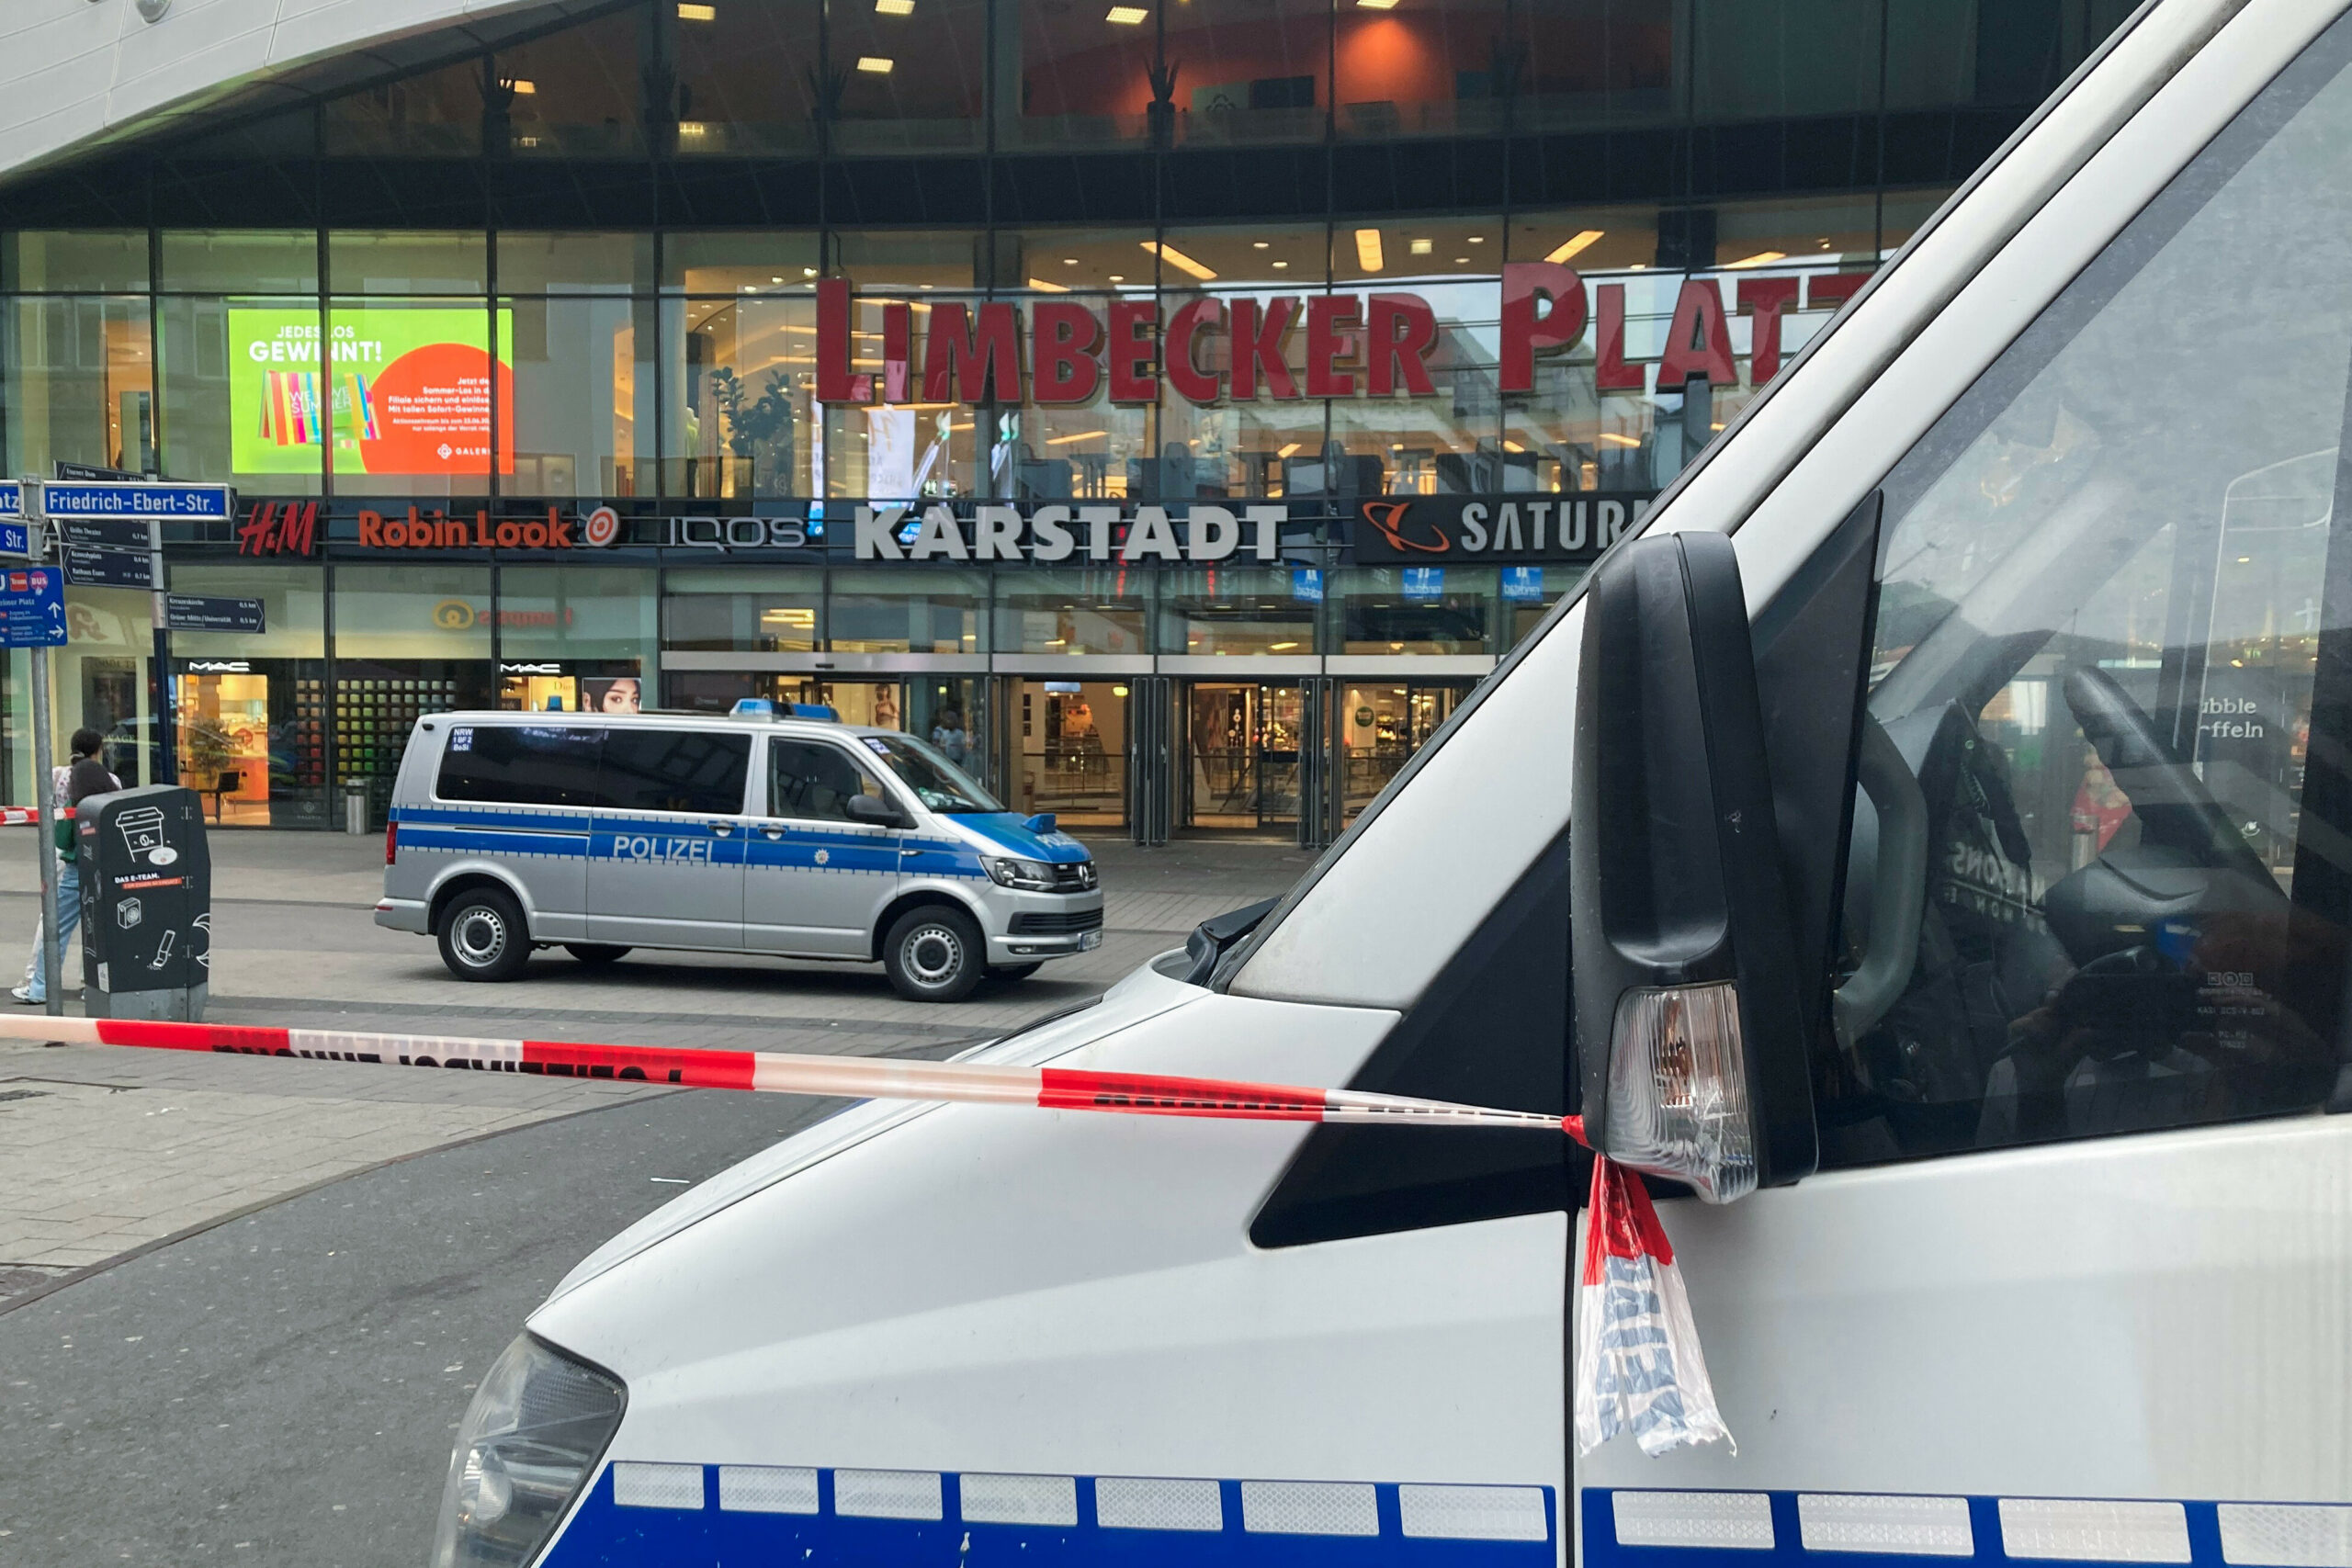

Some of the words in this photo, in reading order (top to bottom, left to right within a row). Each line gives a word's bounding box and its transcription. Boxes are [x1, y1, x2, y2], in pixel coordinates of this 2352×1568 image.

[277, 326, 321, 338] JEDES
[817, 279, 1439, 404] LIMBECKER
[49, 491, 215, 512] Friedrich-Ebert-Str.
[6, 529, 25, 549] Str.
[238, 502, 318, 557] H&M
[358, 506, 469, 547] Robin
[477, 506, 573, 547] Look
[670, 516, 806, 552] IQOS
[854, 505, 1288, 560] KARSTADT
[1461, 501, 1650, 551] SATUR
[31, 577, 47, 585] BUS
[454, 728, 473, 736] NRW
[613, 835, 714, 863] POLIZEI
[114, 875, 130, 884] DAS
